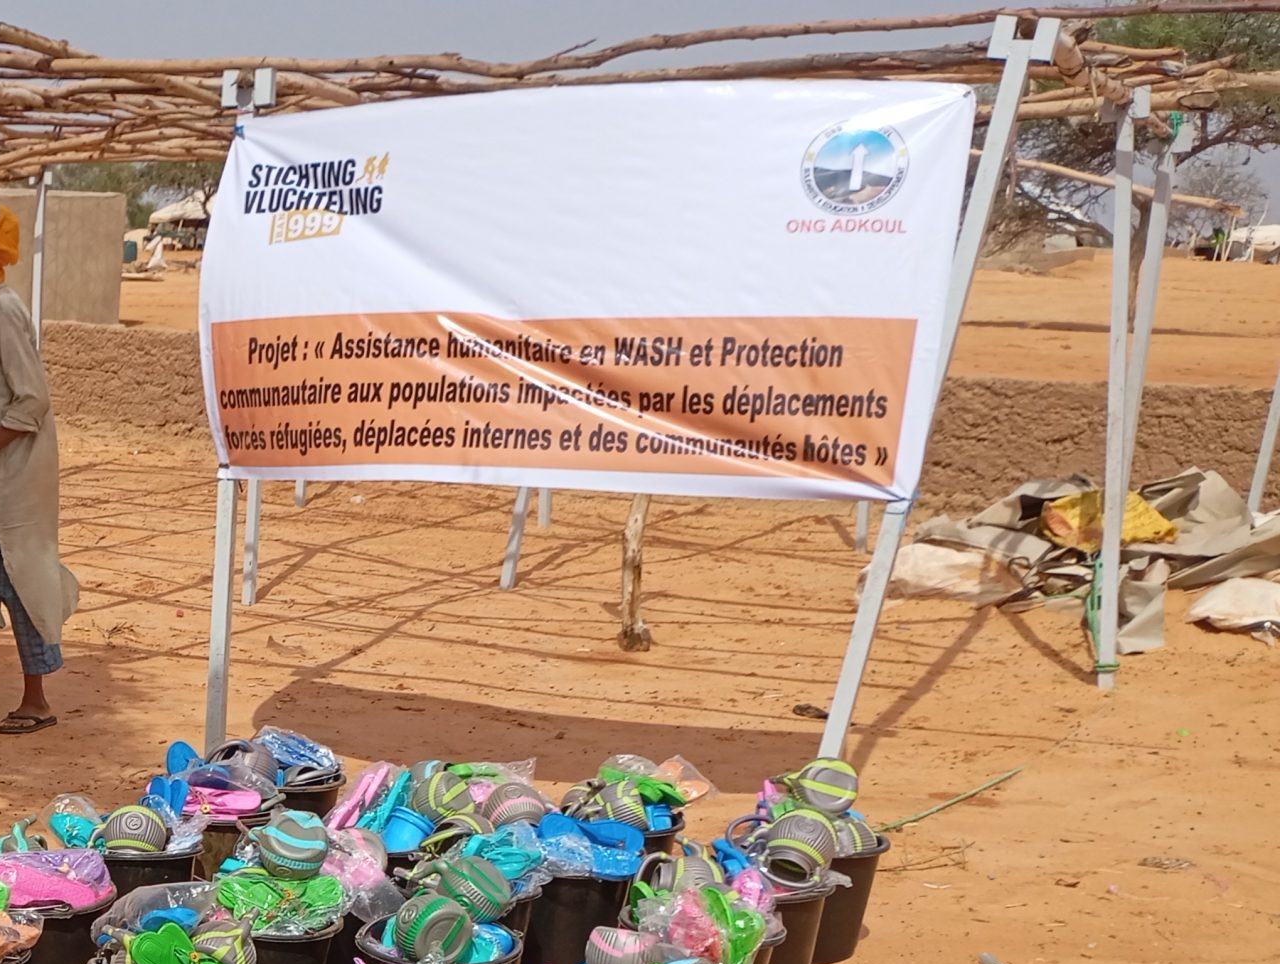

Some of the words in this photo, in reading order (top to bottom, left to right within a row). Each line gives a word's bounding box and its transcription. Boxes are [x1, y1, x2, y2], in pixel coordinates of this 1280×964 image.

[248, 159, 356, 190] STICHTING
[244, 185, 383, 216] VLUCHTELING
[287, 212, 340, 239] 999
[786, 219, 826, 233] ONG
[830, 218, 907, 234] ADKOUL
[248, 336, 297, 370] Projet
[330, 332, 440, 360] Assistance
[579, 345, 605, 366] en
[614, 336, 684, 368] WASH
[689, 337, 714, 367] et
[720, 336, 844, 368] Protection
[219, 377, 342, 410] communautaire
[347, 380, 384, 405] aux
[388, 375, 510, 410] populations
[638, 387, 676, 418] par
[681, 384, 714, 415] les
[722, 384, 888, 423] déplacements
[223, 423, 267, 451] forcés
[270, 420, 347, 455] réfugiées,
[353, 419, 455, 453] déplacées
[462, 420, 551, 450] internes
[559, 424, 581, 451] et
[588, 423, 628, 453] des
[803, 434, 867, 466] hôtes
